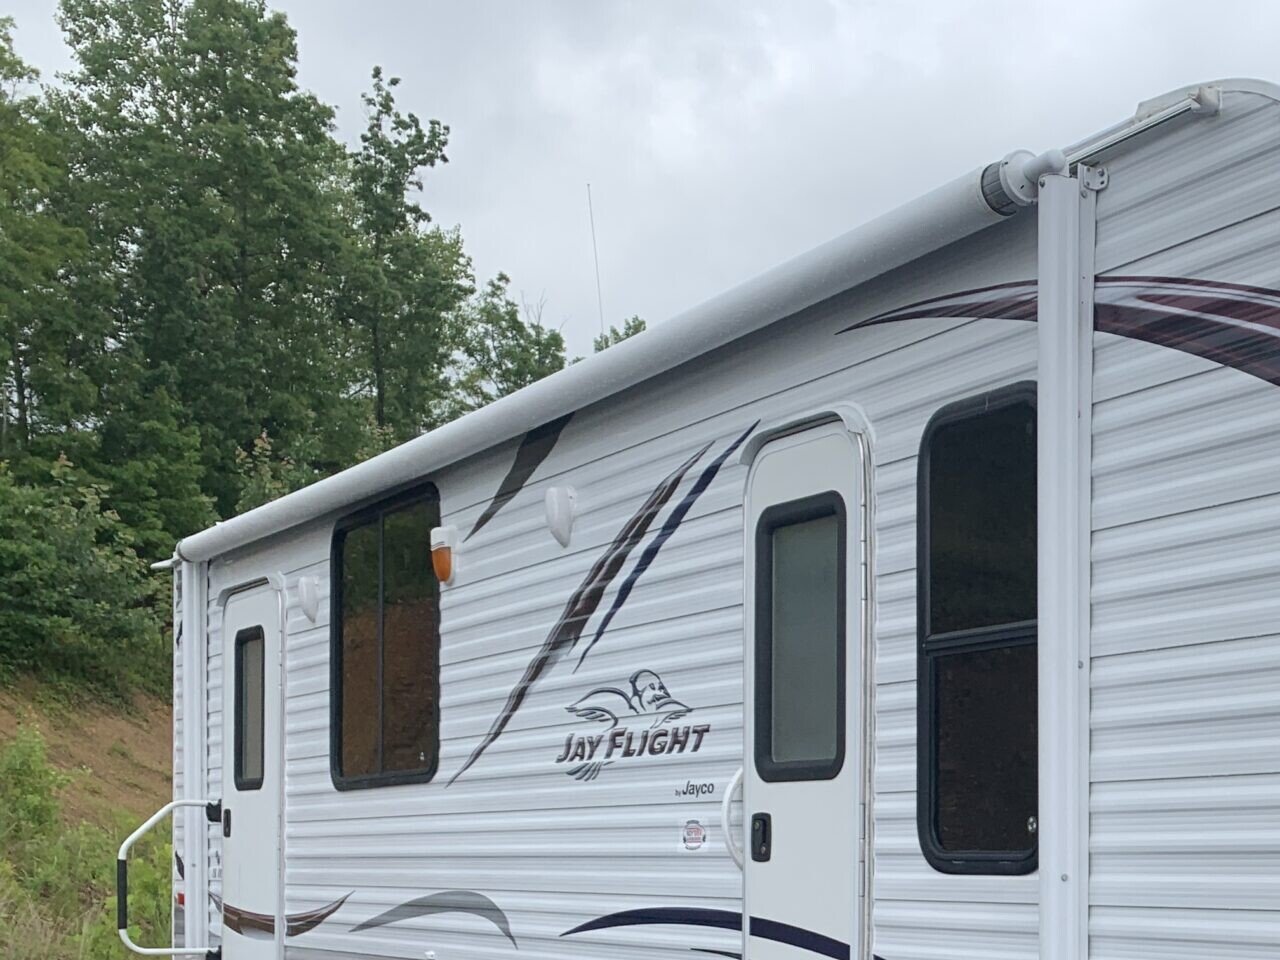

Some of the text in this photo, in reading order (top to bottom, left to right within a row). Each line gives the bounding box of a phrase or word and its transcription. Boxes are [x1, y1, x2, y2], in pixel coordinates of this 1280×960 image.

[556, 724, 711, 763] JAY FLIGHT
[682, 780, 715, 798] Jayco
